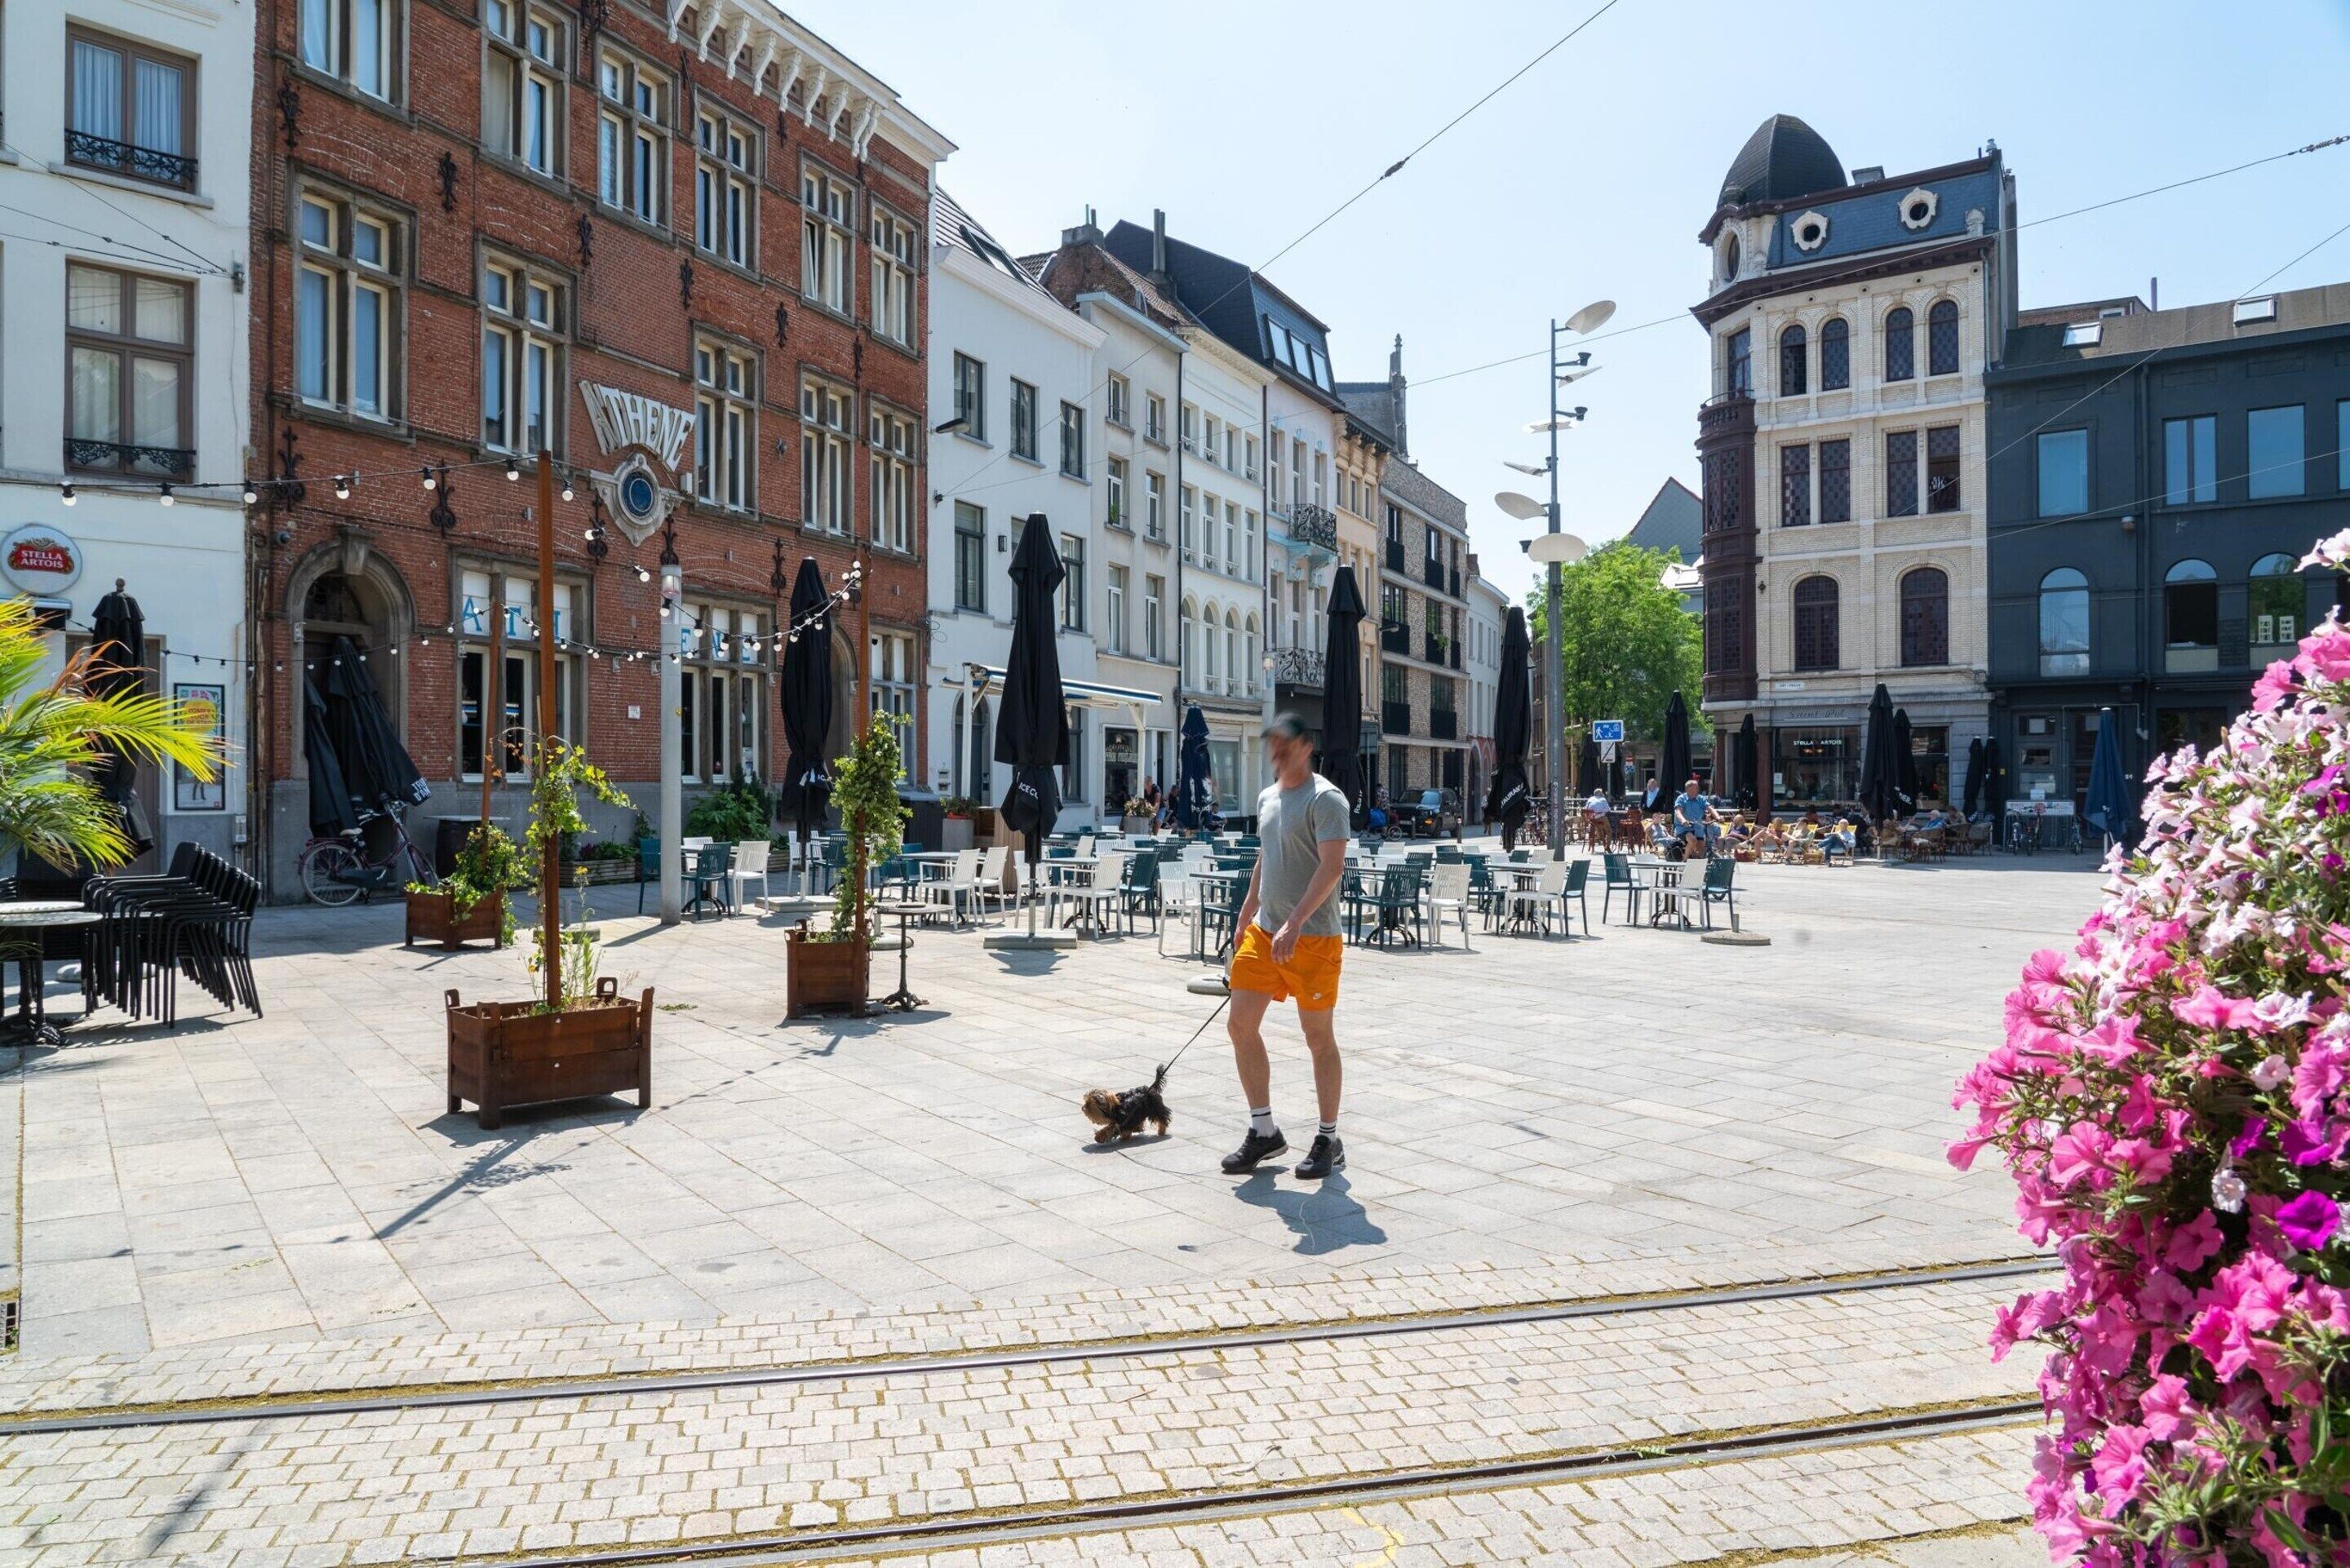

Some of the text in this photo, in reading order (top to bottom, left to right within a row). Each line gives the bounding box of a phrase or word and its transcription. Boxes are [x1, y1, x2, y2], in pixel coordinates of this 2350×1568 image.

[579, 380, 696, 472] ATHENE
[21, 550, 63, 560] STELLA
[20, 558, 64, 569] ARTOIS
[1019, 782, 1031, 794] ICE
